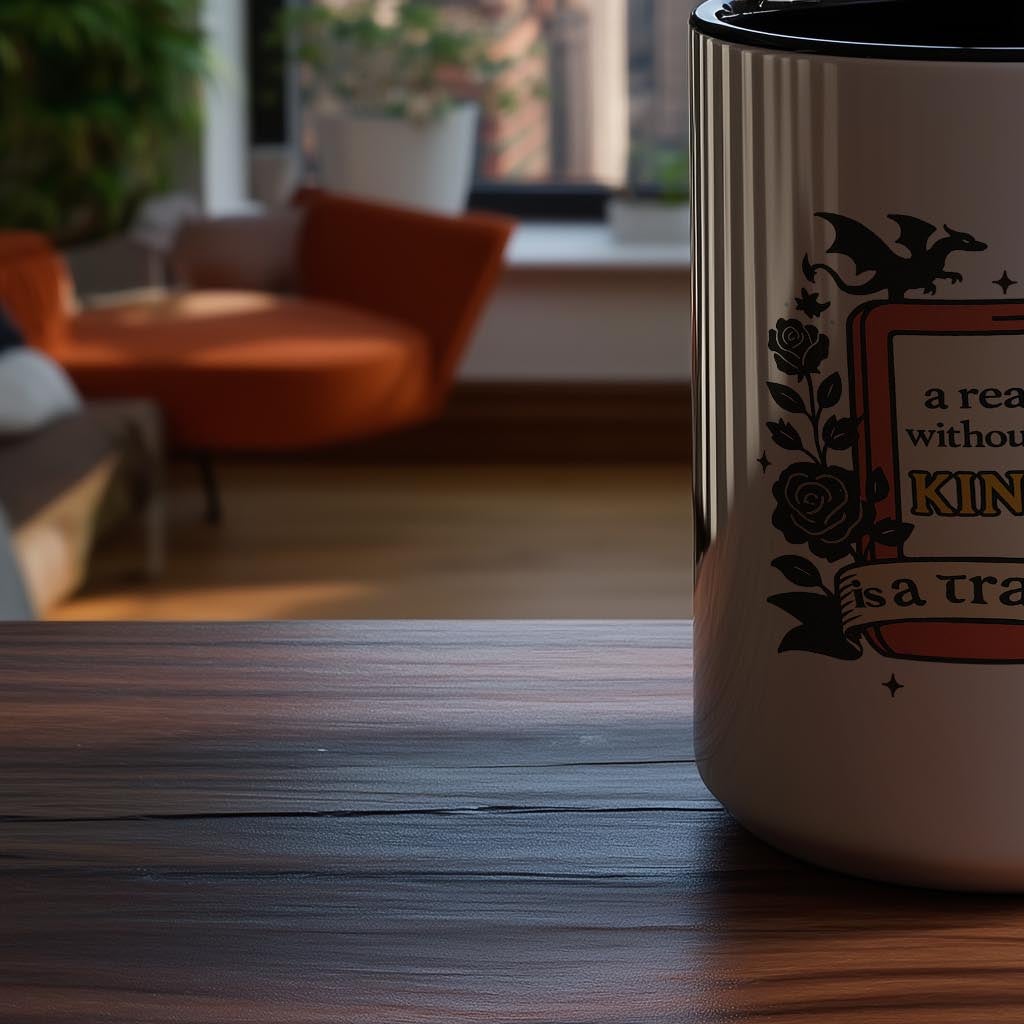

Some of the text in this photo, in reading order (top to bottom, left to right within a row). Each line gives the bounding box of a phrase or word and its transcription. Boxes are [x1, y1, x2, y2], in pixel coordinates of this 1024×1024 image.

[924, 387, 949, 410] a
[852, 580, 886, 609] is
[891, 577, 927, 608] a
